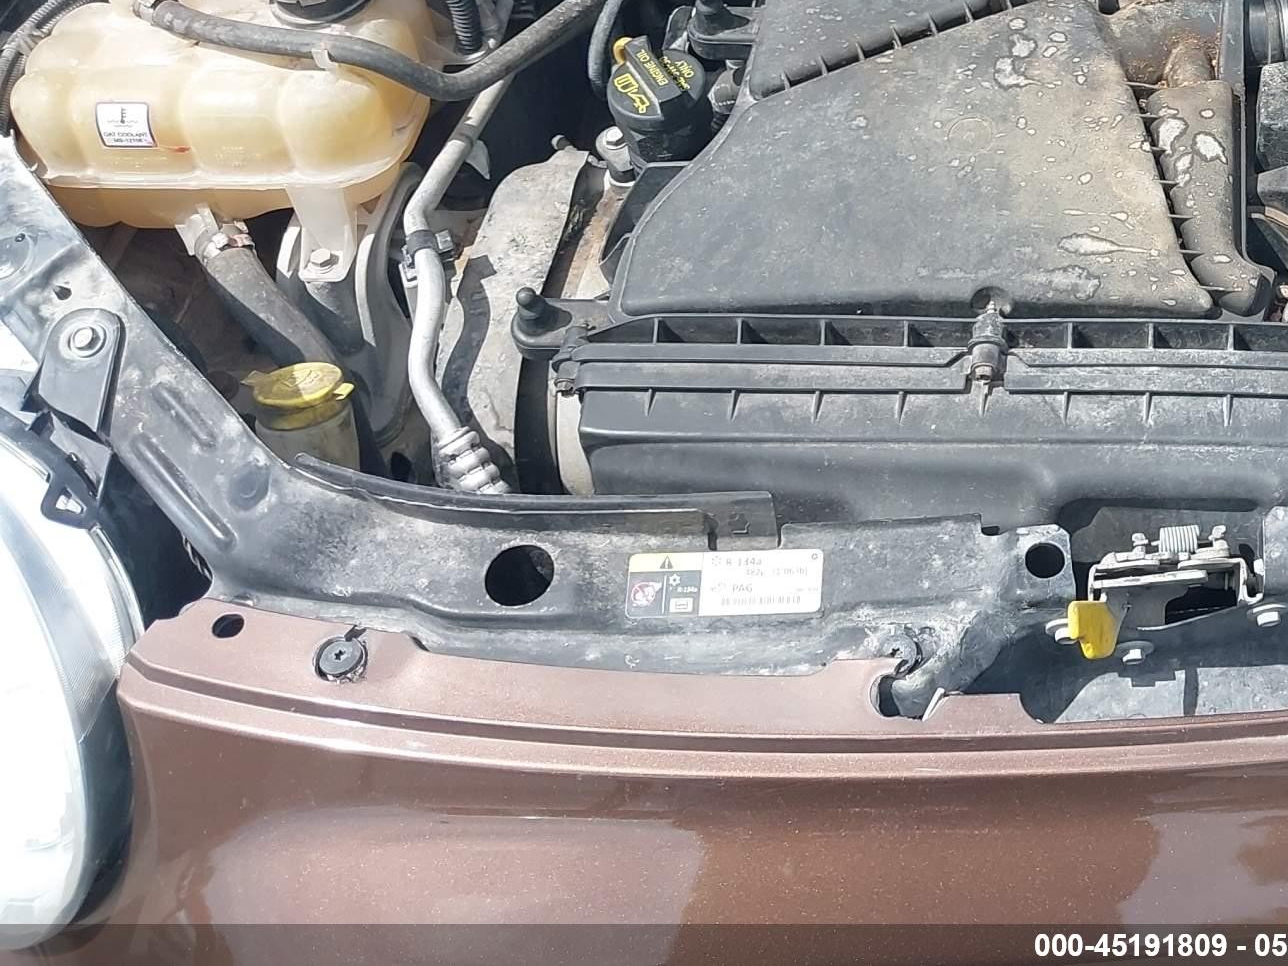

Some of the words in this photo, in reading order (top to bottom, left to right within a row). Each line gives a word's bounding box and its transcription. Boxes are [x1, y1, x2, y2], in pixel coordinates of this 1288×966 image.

[636, 48, 649, 62] OIL
[643, 60, 669, 86] ENGINE
[674, 60, 695, 78] ONLY
